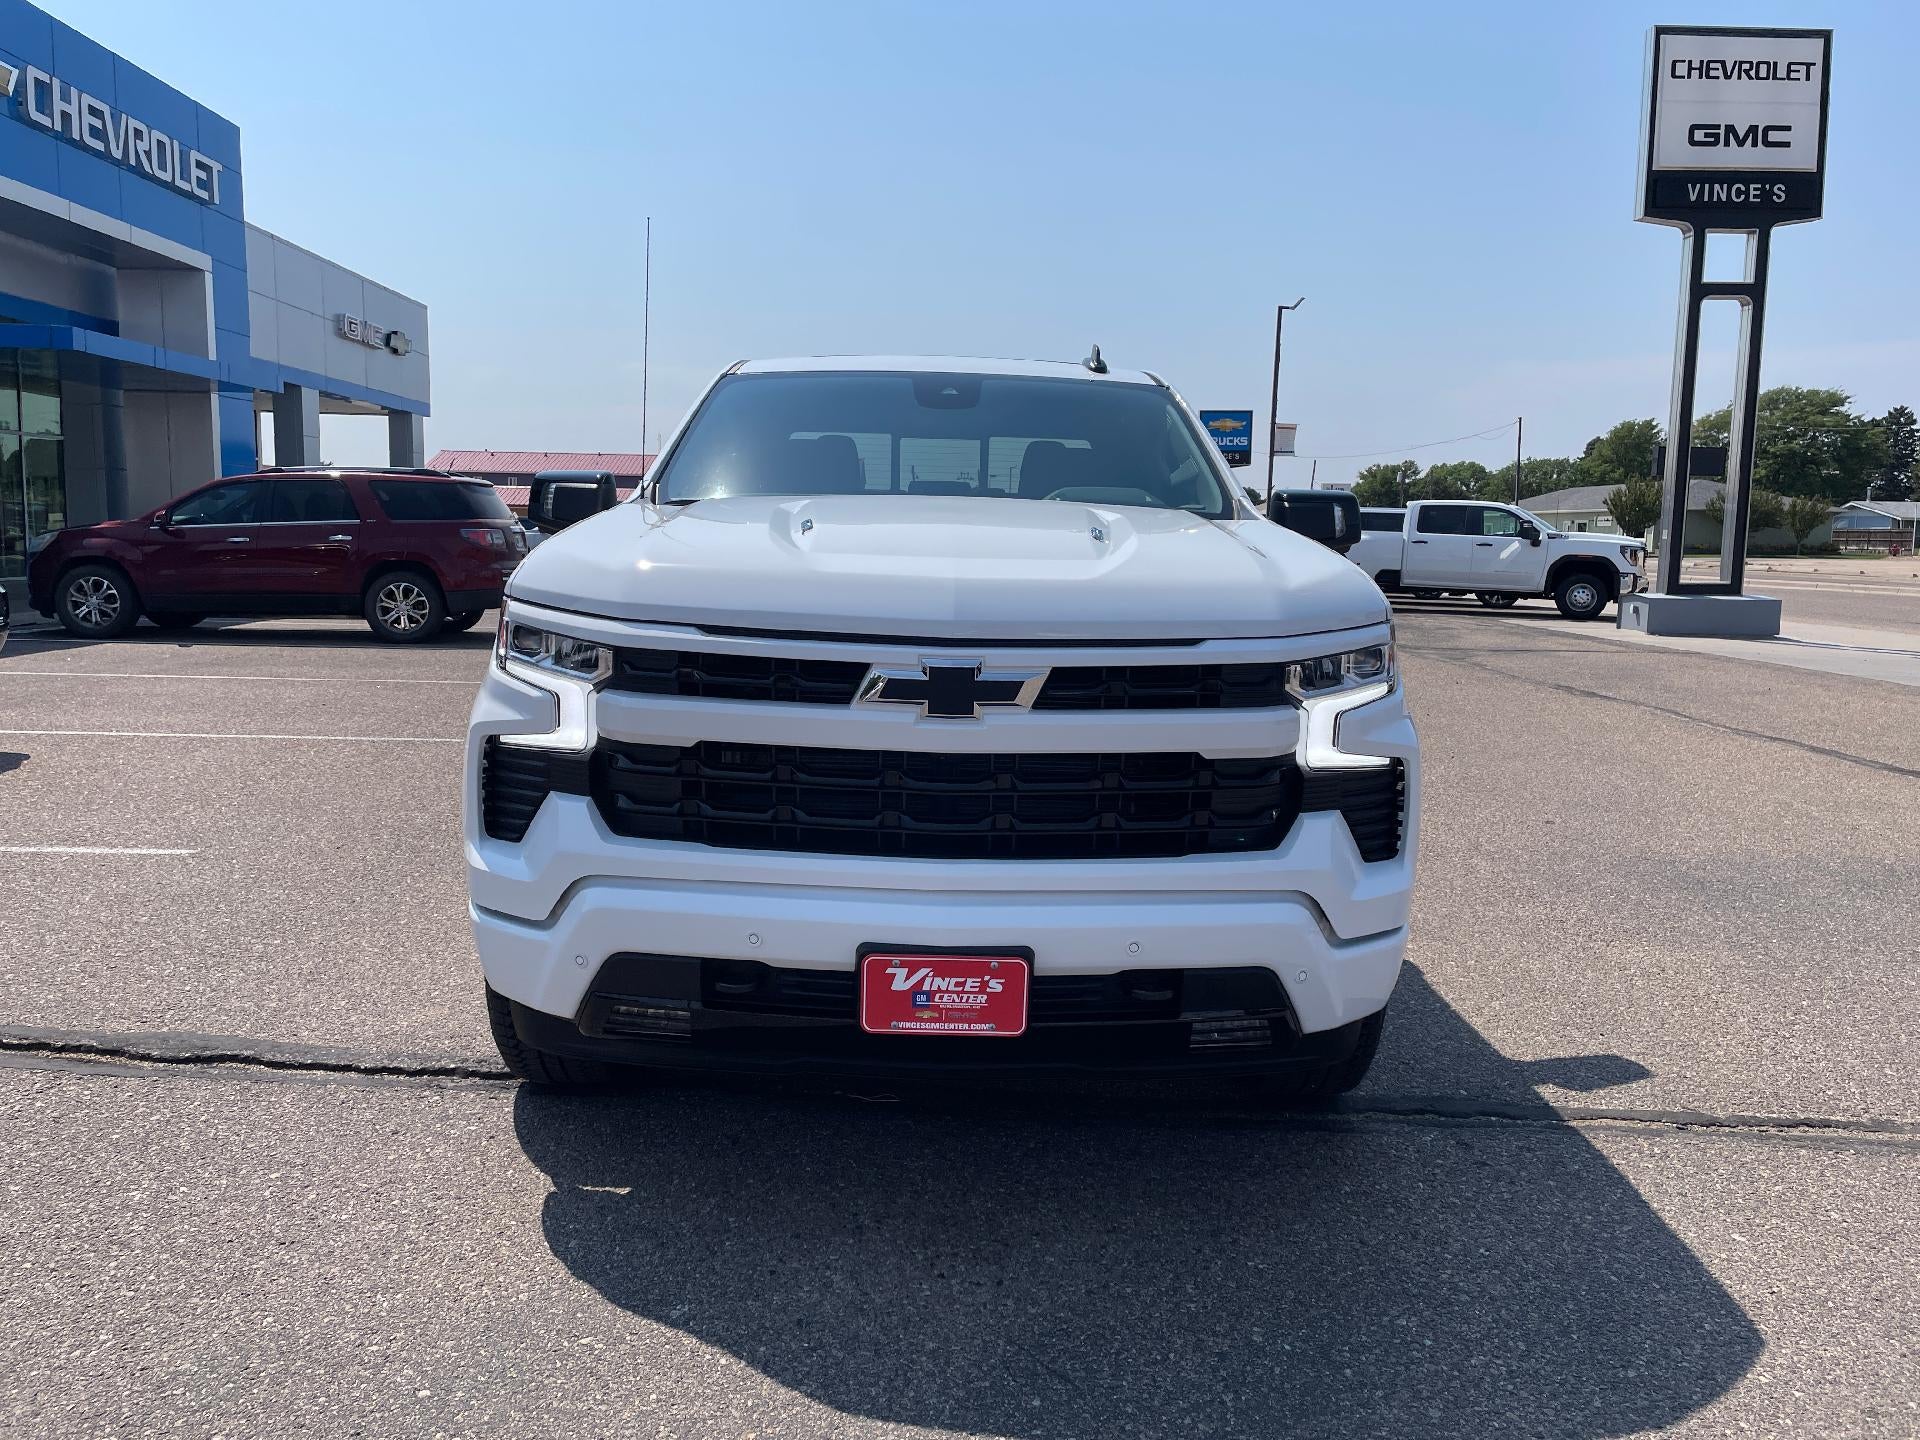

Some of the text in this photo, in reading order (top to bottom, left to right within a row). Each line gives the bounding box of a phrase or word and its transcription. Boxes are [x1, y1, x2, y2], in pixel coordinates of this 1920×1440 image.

[1671, 59, 1816, 81] CHEVROLET
[26, 64, 222, 205] CHEVROLET
[1688, 123, 1792, 148] GMC
[1688, 183, 1786, 203] VINCE'S
[916, 993, 988, 1004] GM CENTER
